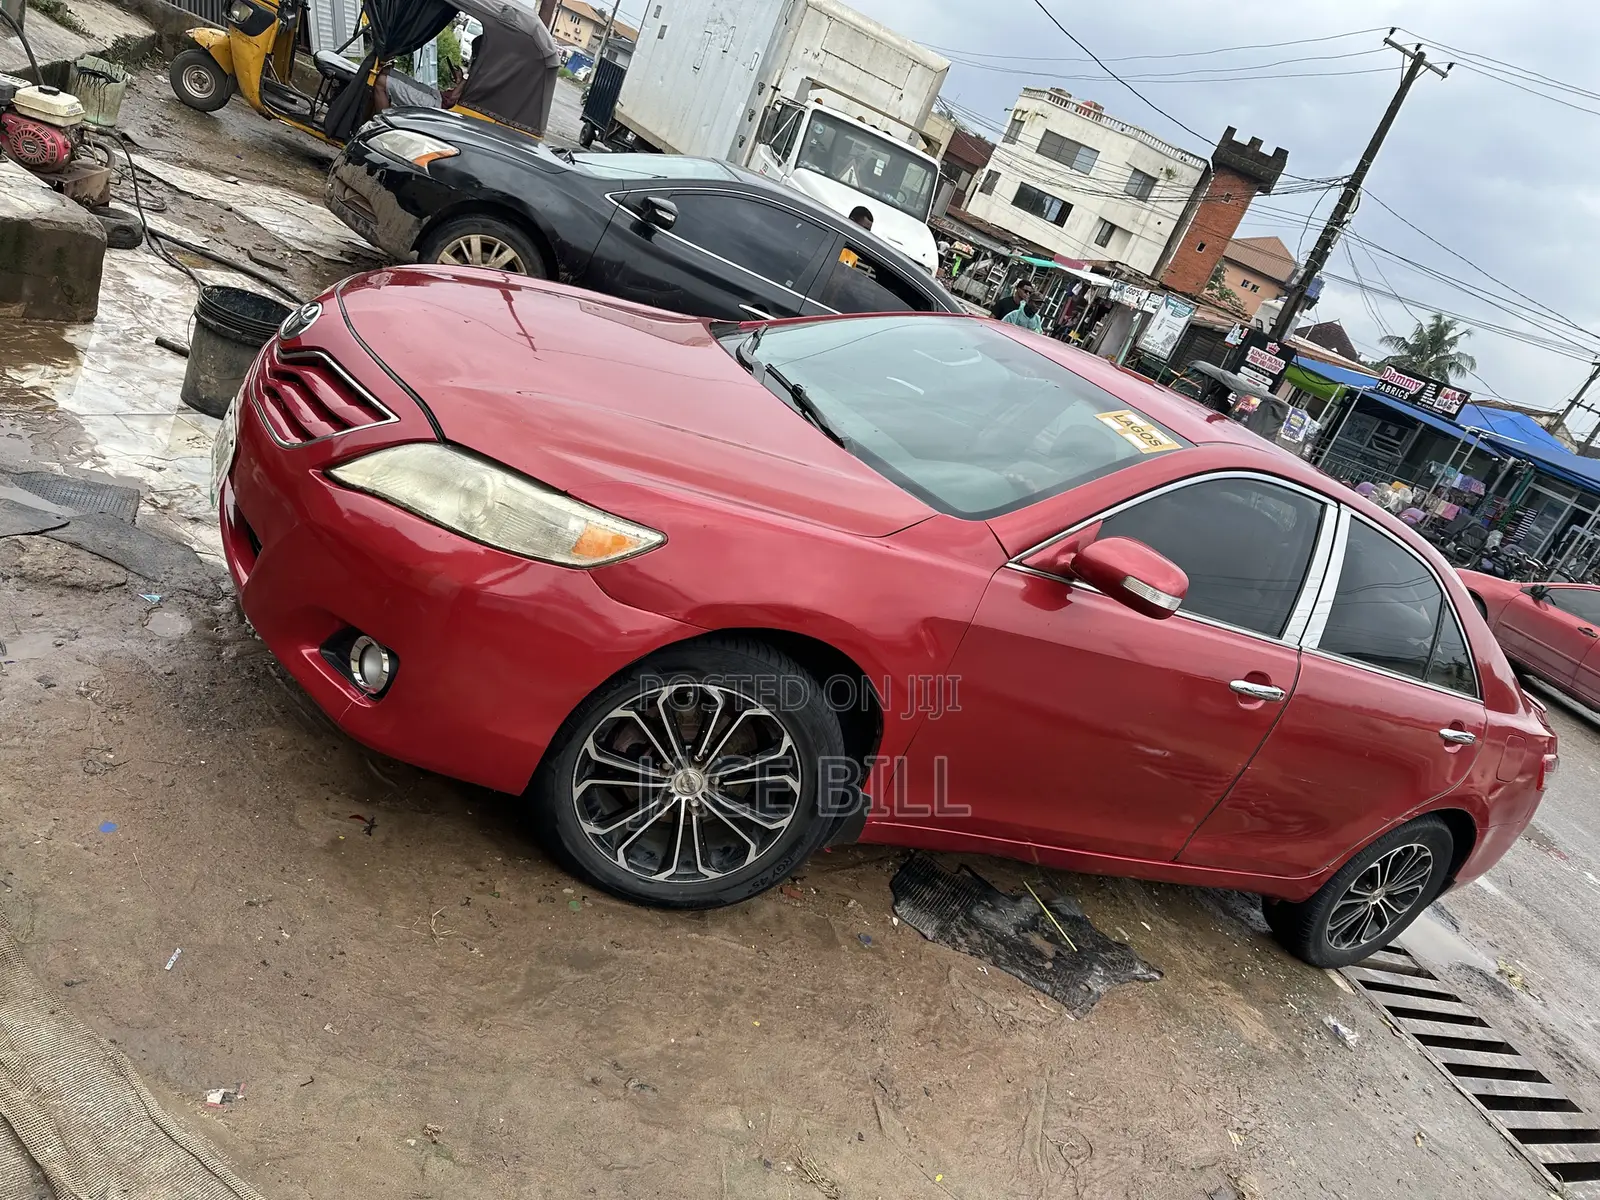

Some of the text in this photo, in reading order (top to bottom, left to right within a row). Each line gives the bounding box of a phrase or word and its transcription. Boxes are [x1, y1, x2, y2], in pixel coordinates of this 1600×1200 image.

[1250, 348, 1284, 368] KINGS ROYAL
[1376, 381, 1410, 400] FABRICS
[1381, 366, 1424, 395] Dammy
[1114, 414, 1163, 447] LAGOS
